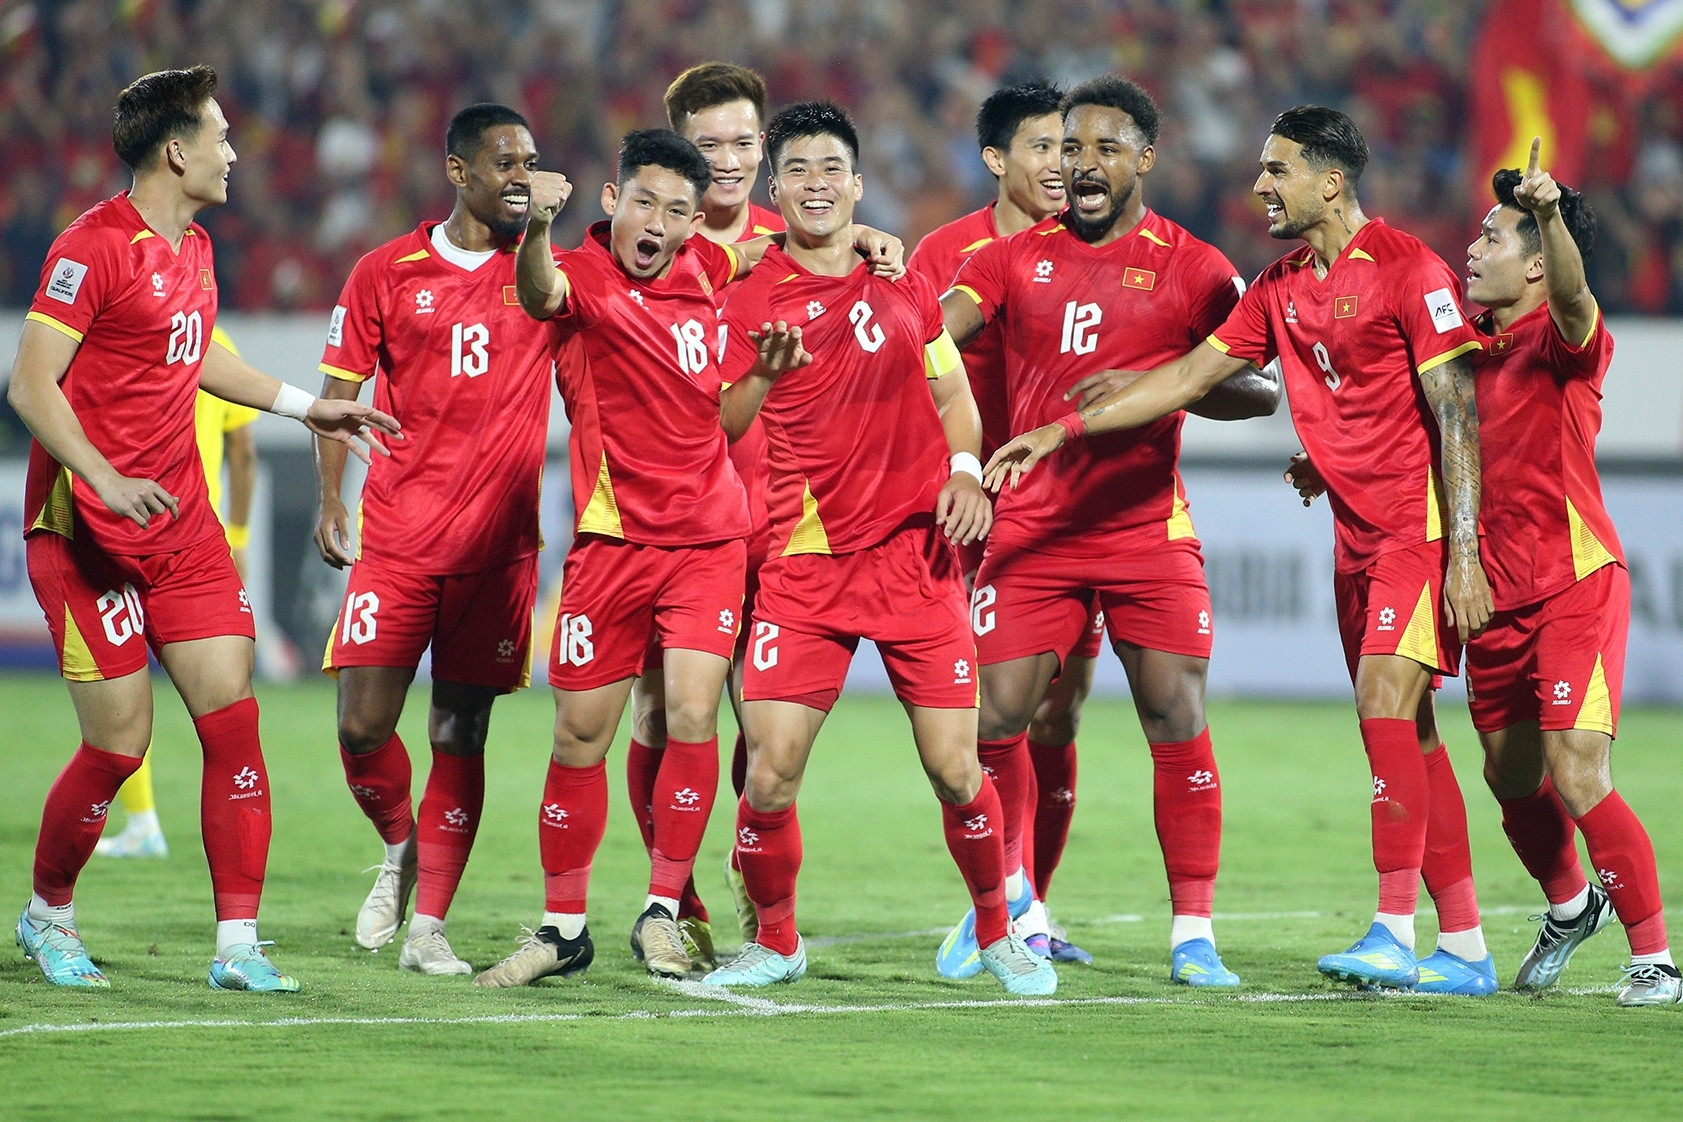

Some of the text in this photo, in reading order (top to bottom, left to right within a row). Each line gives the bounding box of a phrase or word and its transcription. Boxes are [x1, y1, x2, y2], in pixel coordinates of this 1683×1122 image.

[165, 309, 203, 366] 20
[848, 300, 887, 354] 2
[1058, 300, 1102, 356] 12
[1435, 303, 1453, 317] AFC
[451, 322, 490, 378] 13
[670, 318, 709, 375] 18
[1311, 341, 1341, 392] 9
[96, 581, 145, 647] 20
[342, 591, 380, 646] 13
[558, 613, 595, 667] 18
[753, 621, 780, 673] 2
